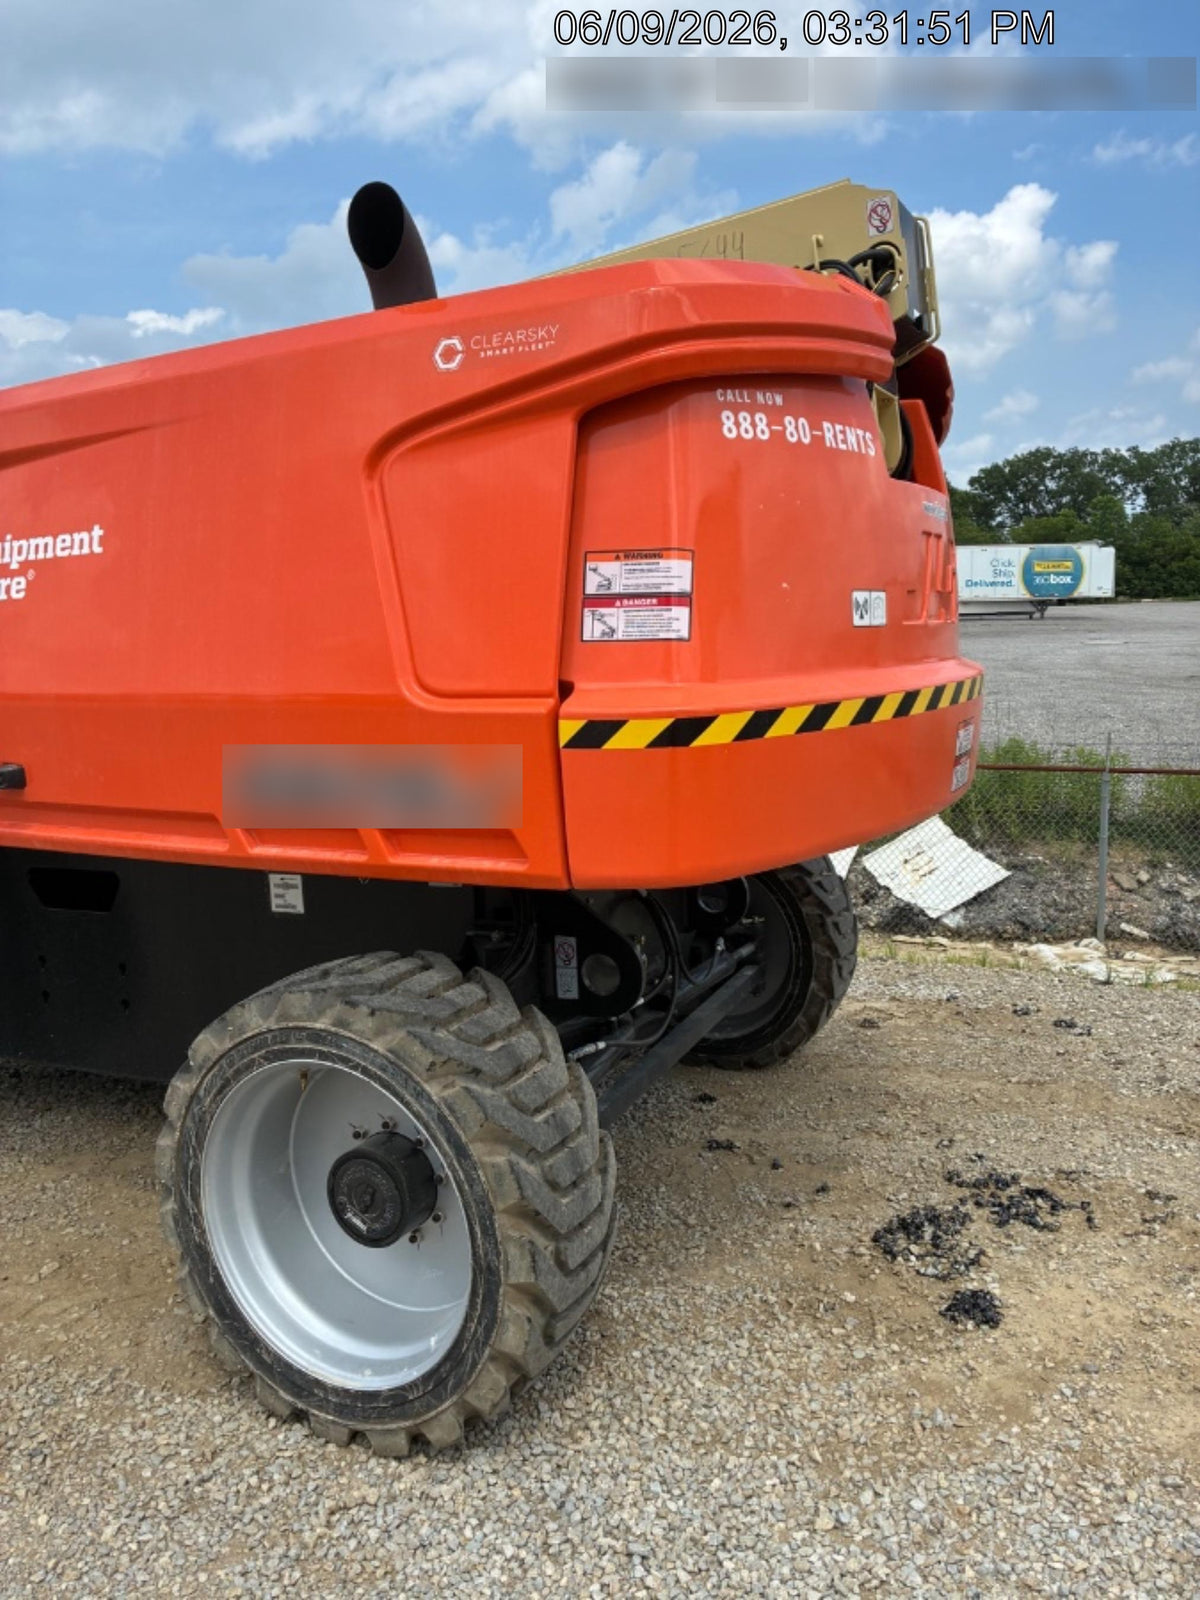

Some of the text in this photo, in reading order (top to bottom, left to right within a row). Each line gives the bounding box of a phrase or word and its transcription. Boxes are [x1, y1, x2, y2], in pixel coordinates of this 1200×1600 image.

[470, 324, 560, 349] CLEARSKY
[480, 345, 514, 358] SMART
[716, 388, 784, 406] CALL NOW
[720, 410, 876, 456] 888-80-RENTS
[621, 598, 658, 606] DANGER
